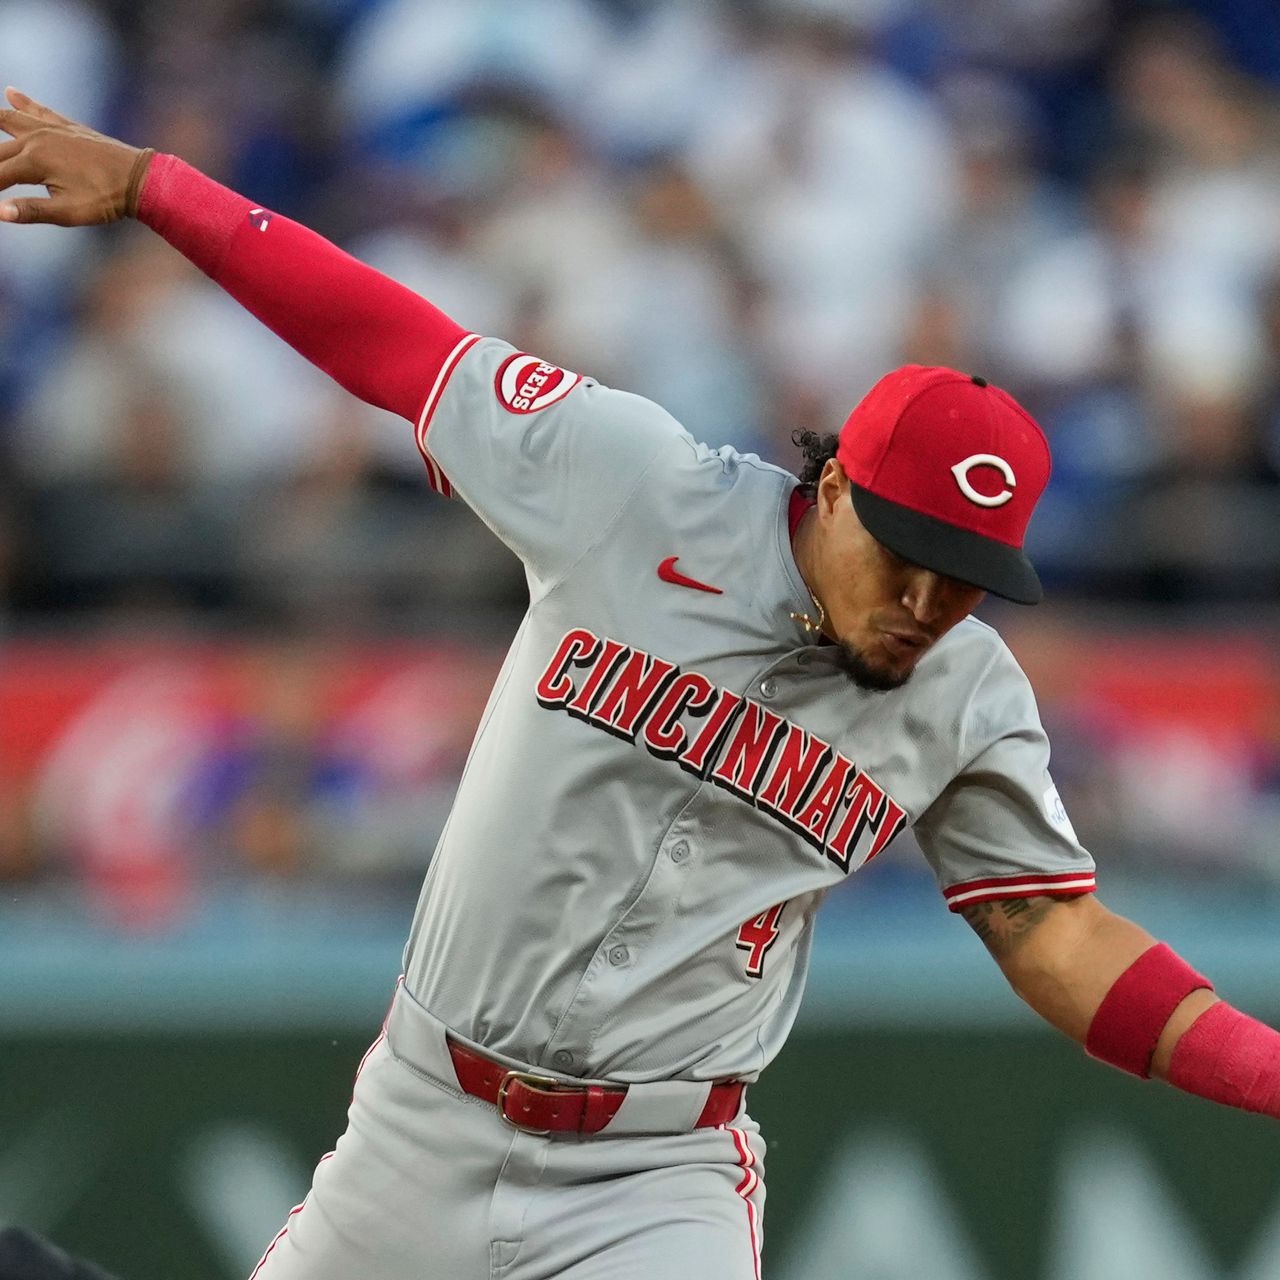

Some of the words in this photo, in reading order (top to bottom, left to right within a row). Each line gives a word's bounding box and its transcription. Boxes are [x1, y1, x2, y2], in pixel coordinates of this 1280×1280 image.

[511, 362, 558, 410] REDS
[950, 453, 1017, 509] C
[536, 628, 908, 875] CINCINNATI
[736, 901, 787, 979] 4
